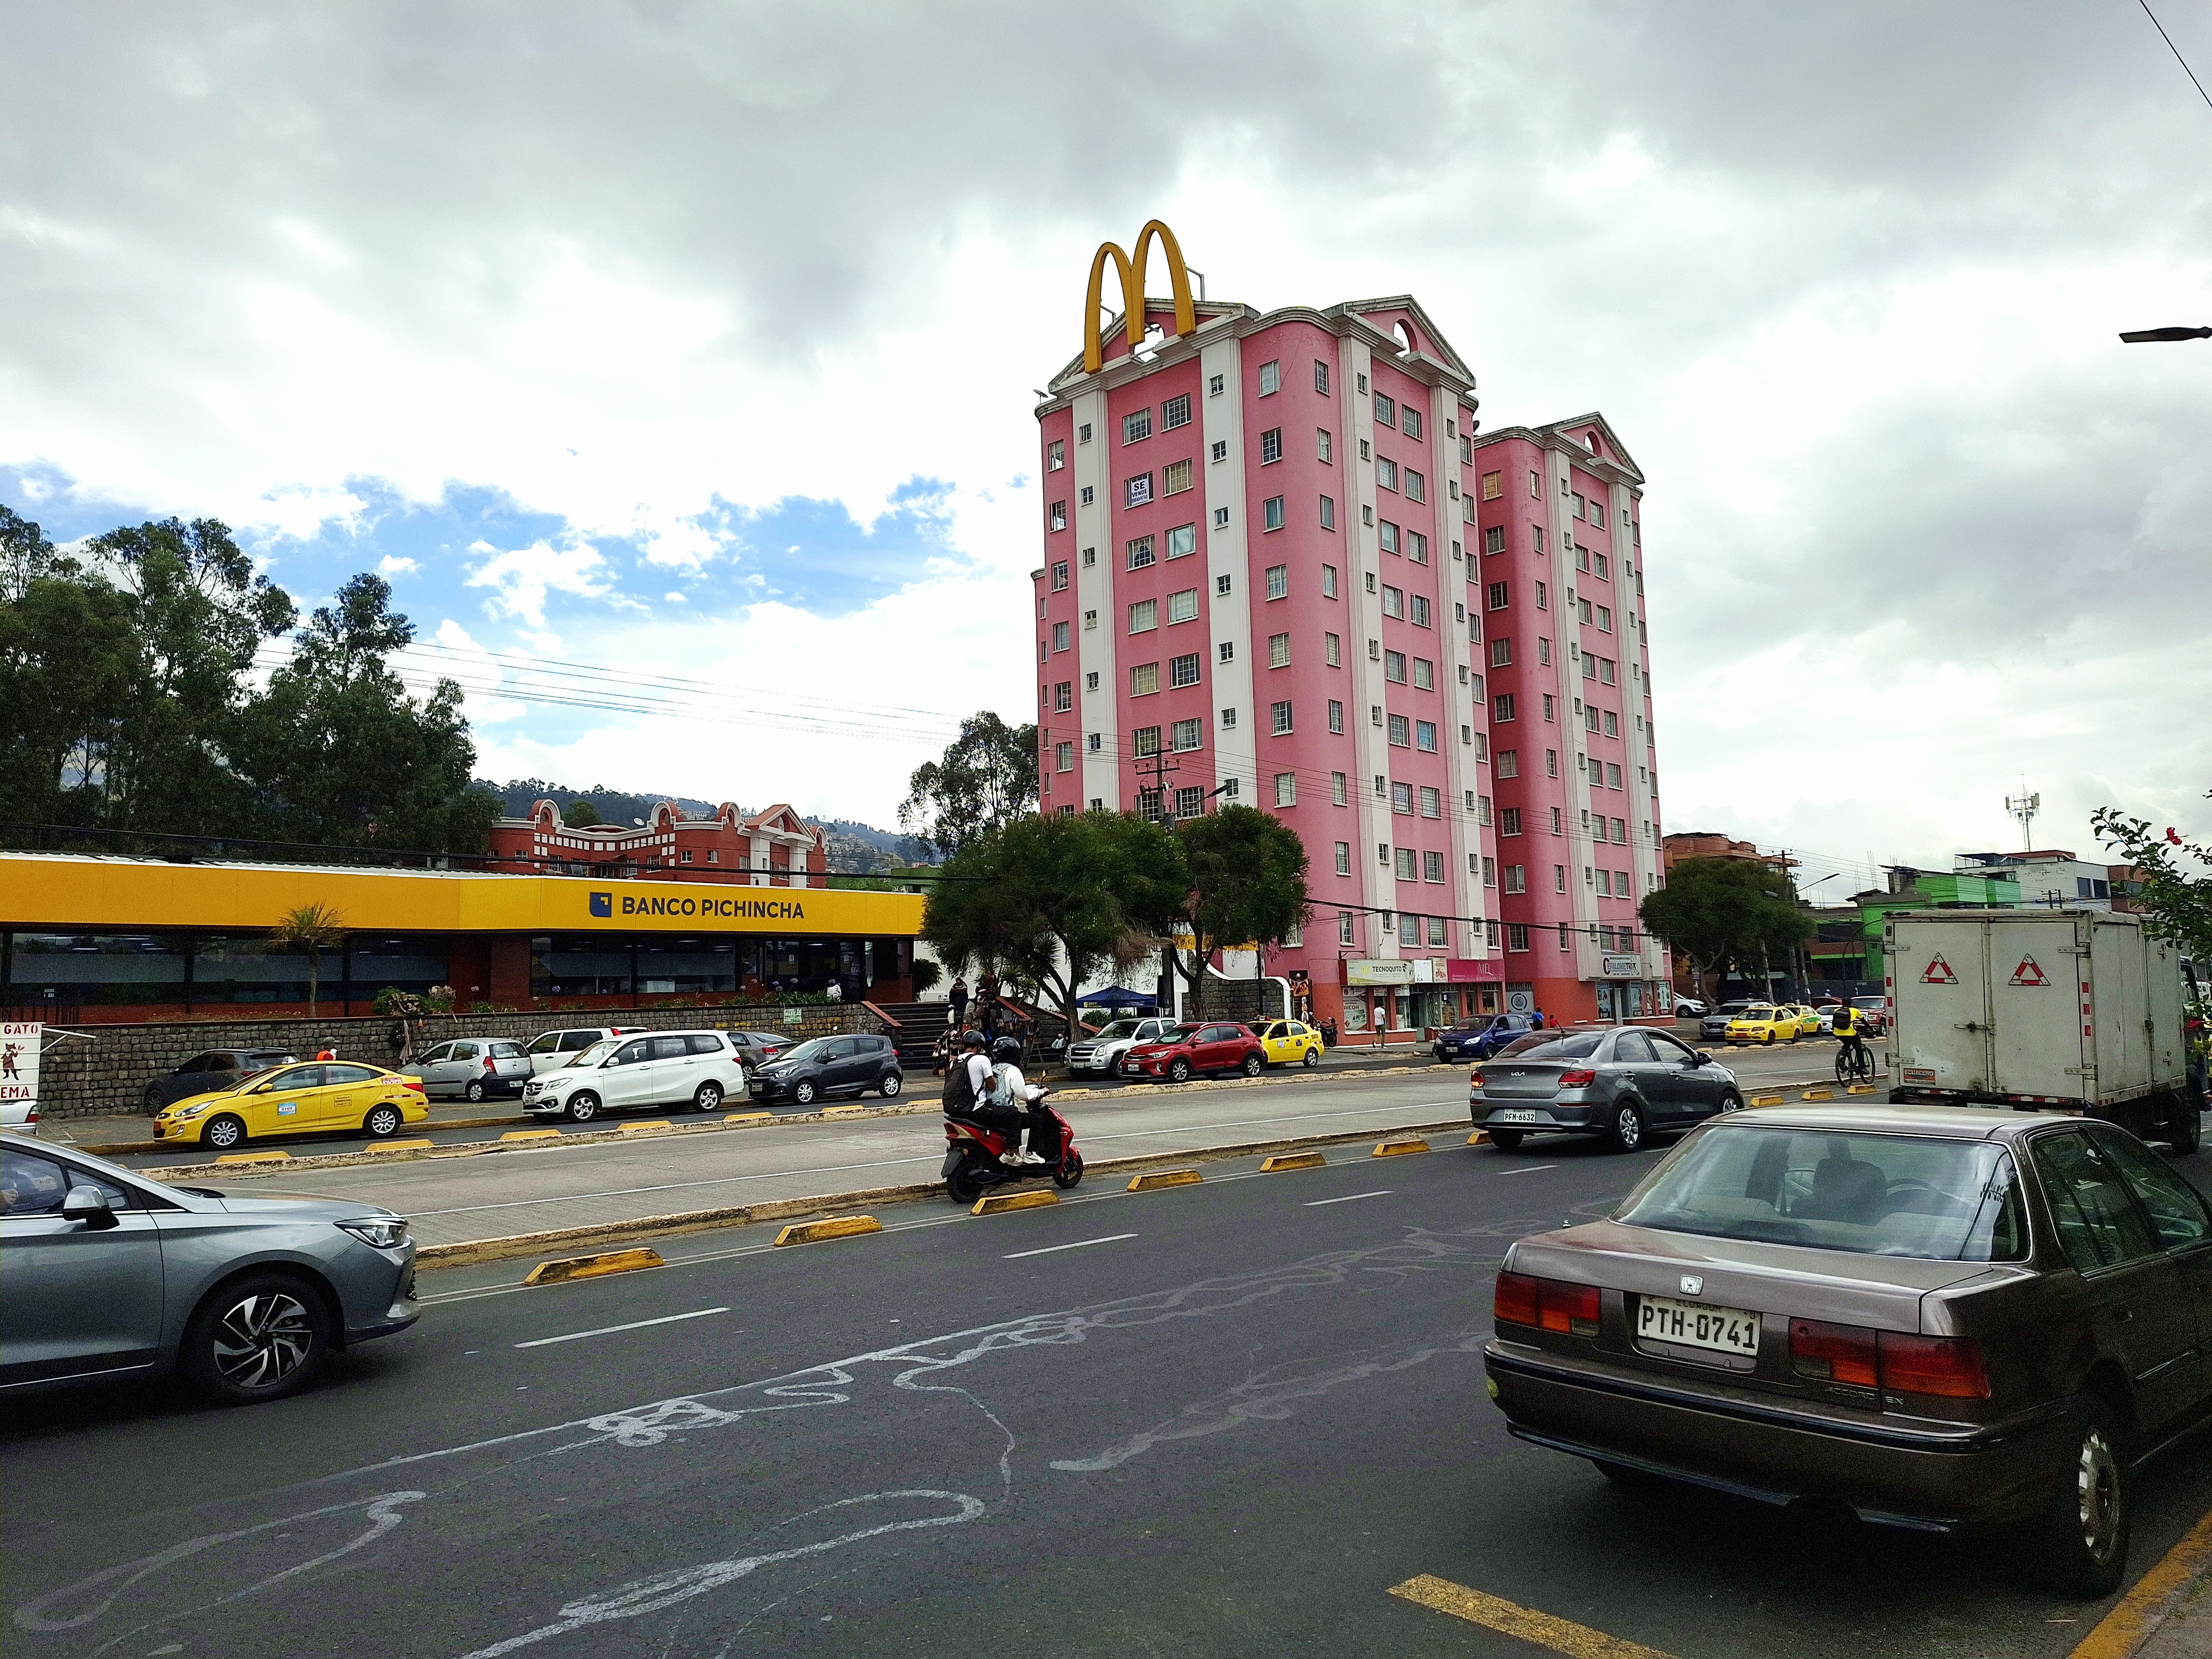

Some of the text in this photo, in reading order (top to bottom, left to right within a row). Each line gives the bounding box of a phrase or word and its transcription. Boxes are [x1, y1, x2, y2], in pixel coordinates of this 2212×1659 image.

[1134, 481, 1145, 491] SE
[1132, 488, 1147, 498] VENDE
[622, 896, 805, 919] BANCO PICHINCHA
[4, 1024, 38, 1035] GATO
[1642, 1305, 1755, 1349] PTH-0741
[1885, 1396, 1903, 1405] EX
